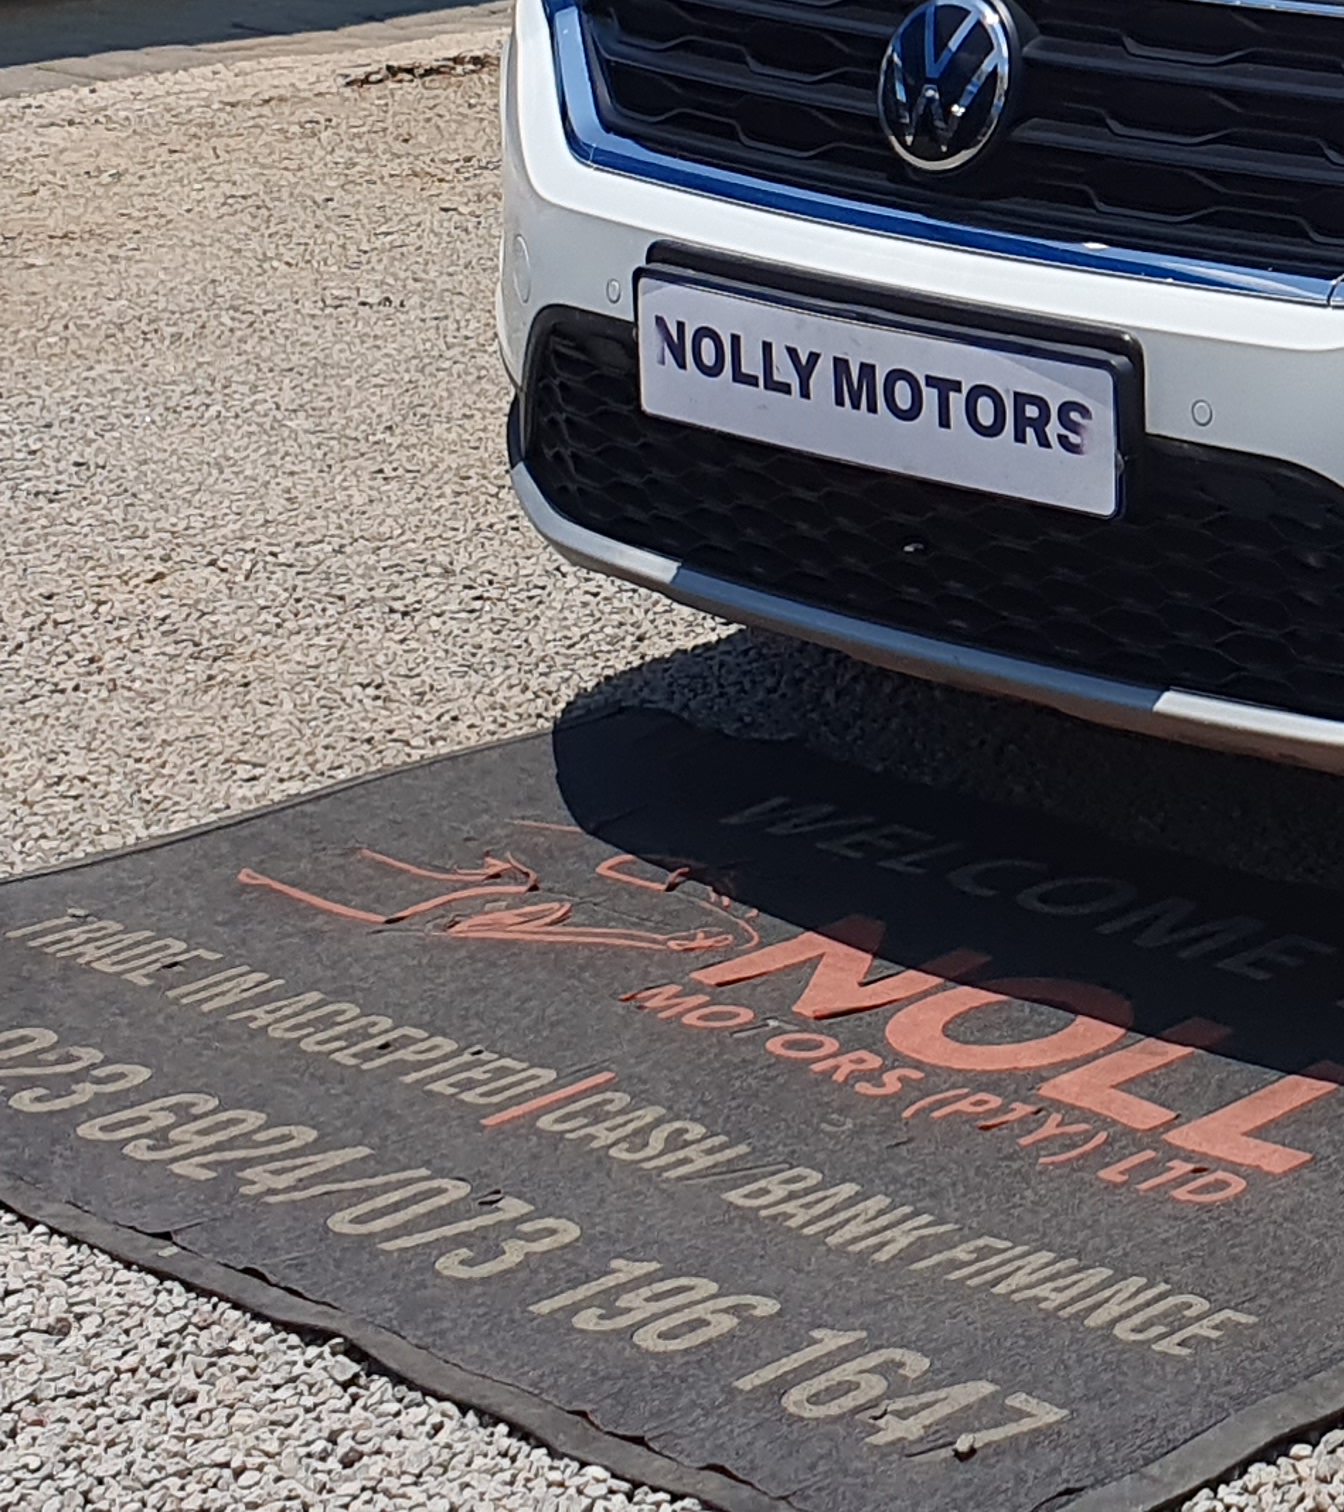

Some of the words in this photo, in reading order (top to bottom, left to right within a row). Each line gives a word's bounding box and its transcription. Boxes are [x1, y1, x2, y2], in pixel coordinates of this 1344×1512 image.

[654, 314, 821, 400] NOLLY
[832, 355, 1094, 455] MOTORS
[718, 795, 1338, 982] WELCOME
[5, 908, 223, 987] TRADE
[165, 965, 286, 1013] IN
[226, 990, 558, 1106] ACCEPTED
[907, 1235, 1260, 1356] FINANCE
[902, 1087, 1109, 1166] (PTY)
[1097, 1149, 1248, 1204] LTD
[527, 1257, 782, 1354] 196
[733, 1327, 1073, 1461] 1647
